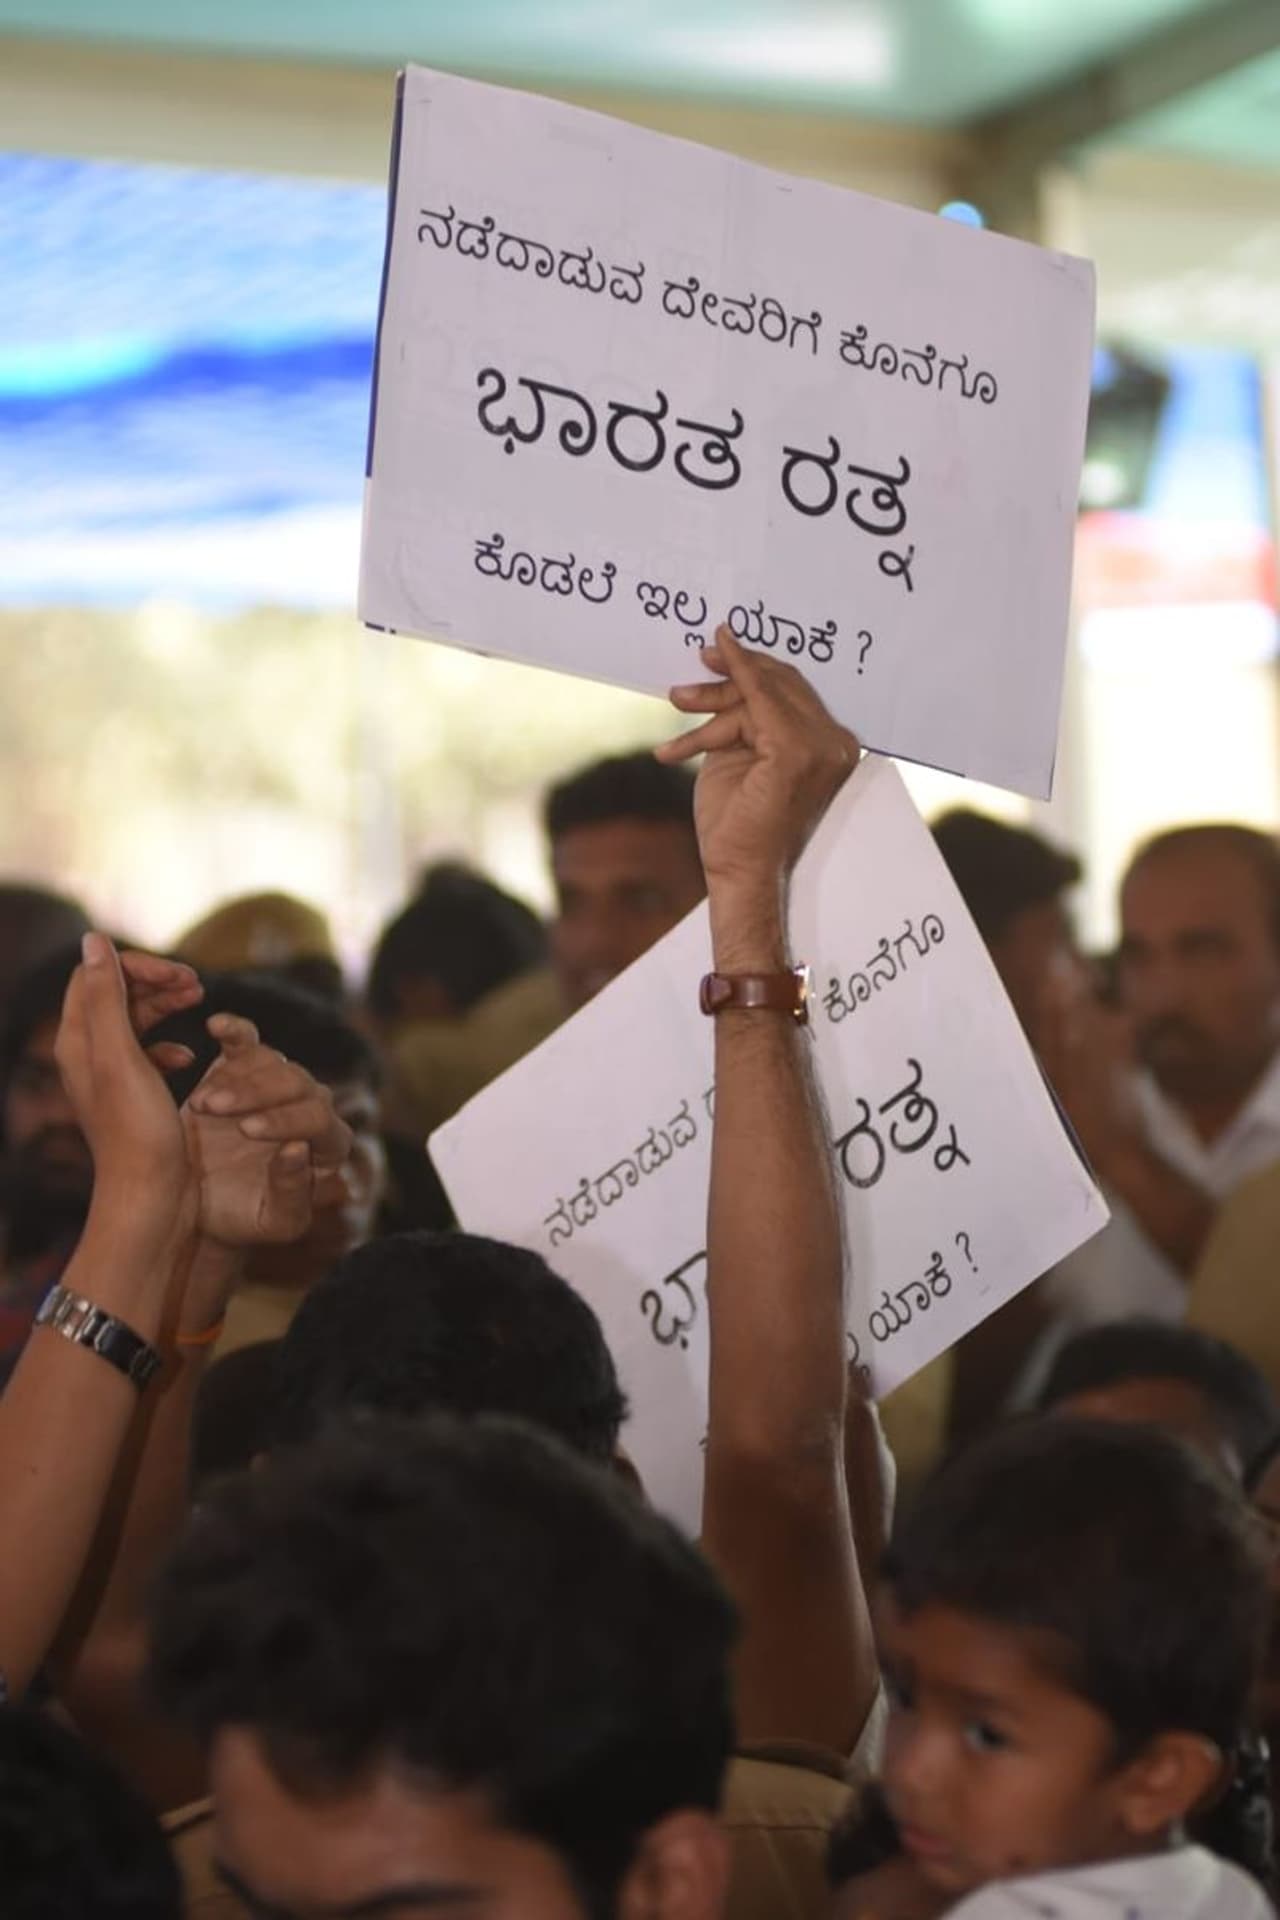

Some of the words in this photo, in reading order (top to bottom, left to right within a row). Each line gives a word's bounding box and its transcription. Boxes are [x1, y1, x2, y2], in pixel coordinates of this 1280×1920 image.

[416, 205, 645, 306] ನಡೆದಾಡುವ
[661, 276, 821, 355] ದೇವರಿಗೆ
[838, 325, 999, 405] ಕೊನೆಗೂ
[475, 367, 744, 490] ಭಾರತ
[781, 436, 914, 592] ರತ್ನ
[474, 534, 617, 604] ಕೊಡಲೆ
[637, 581, 710, 649] ಇಲ್ಲ
[727, 599, 838, 663] ಯಾಕೆ
[544, 1100, 698, 1246] ನಡೆದಾಡುವ
[822, 912, 946, 1025] ಕೊನೆಗೂ
[835, 1059, 971, 1188] ರತ್ನ
[868, 1252, 954, 1343] ಯಾಕೆ
